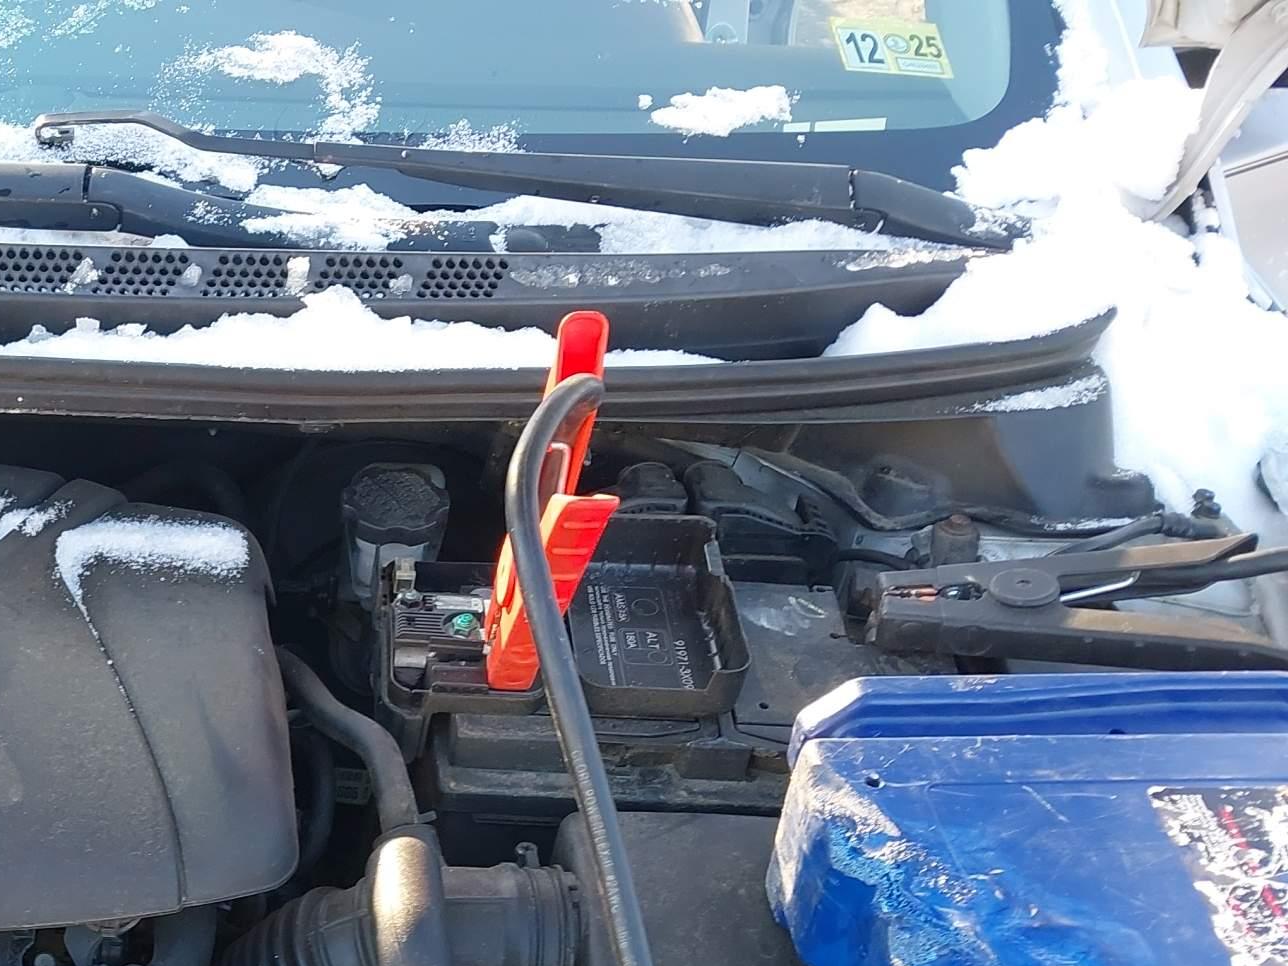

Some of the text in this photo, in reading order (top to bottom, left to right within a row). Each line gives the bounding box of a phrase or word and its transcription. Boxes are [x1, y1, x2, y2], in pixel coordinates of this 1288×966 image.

[845, 32, 942, 64] 12 25
[646, 632, 660, 650] ALT
